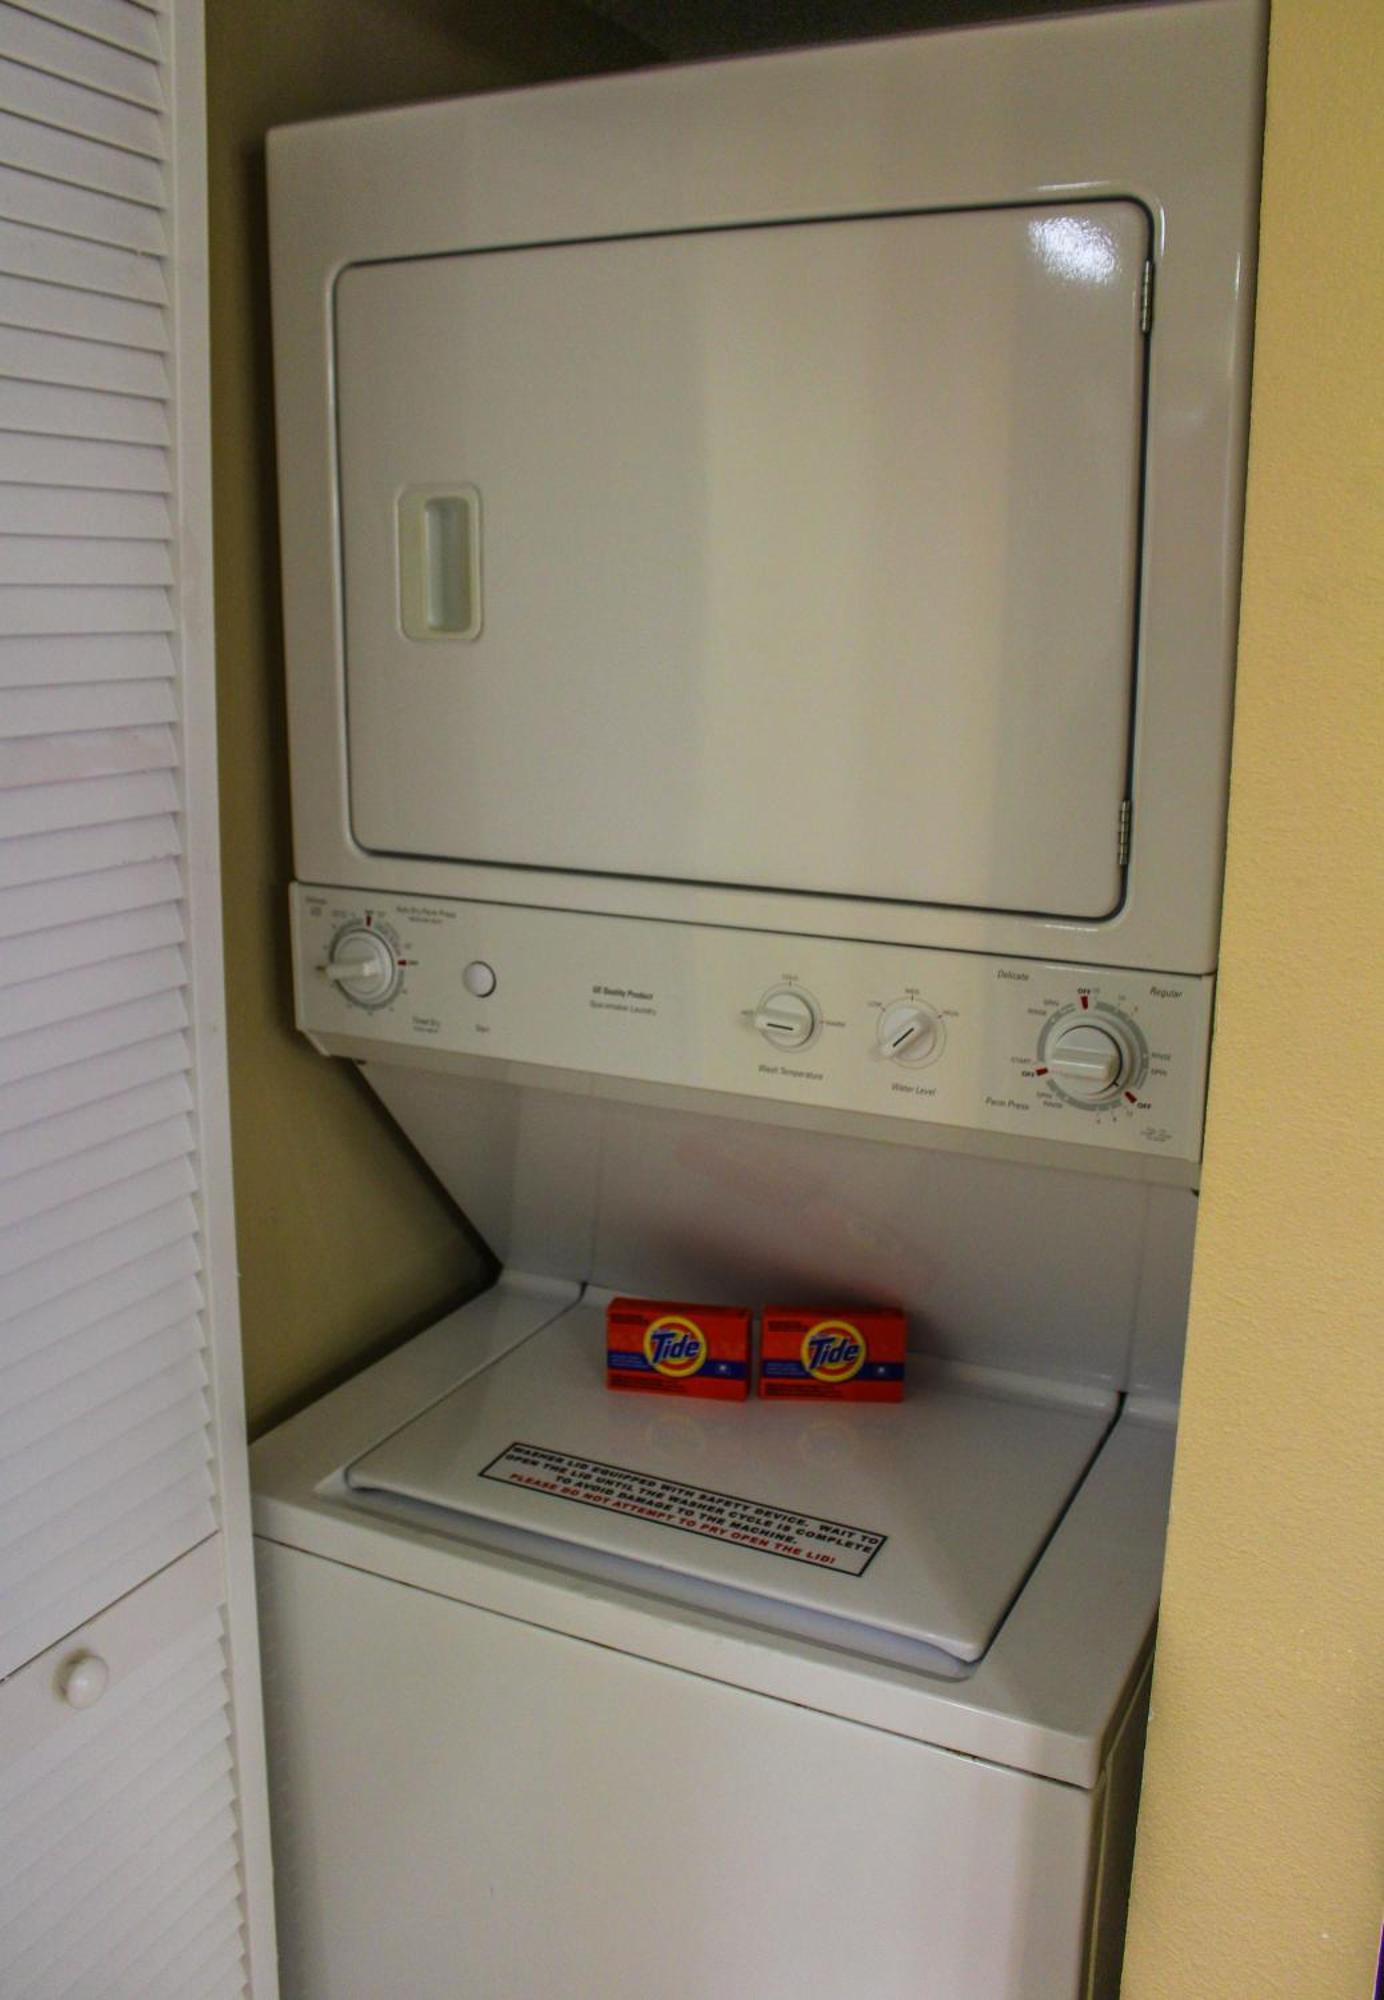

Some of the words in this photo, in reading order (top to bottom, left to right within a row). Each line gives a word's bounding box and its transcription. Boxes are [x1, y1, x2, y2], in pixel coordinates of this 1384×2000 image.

[997, 970, 1030, 982] Delicate
[1150, 986, 1183, 999] Regular
[1021, 1070, 1036, 1078] OFF
[891, 1082, 914, 1095] Water
[915, 1086, 936, 1097] Level
[985, 1096, 1007, 1108] Perm
[1008, 1098, 1030, 1111] Press
[1137, 1102, 1152, 1110] OFF
[651, 1331, 701, 1364] Tide
[808, 1336, 861, 1370] Tide
[505, 1454, 539, 1466] OPEN
[543, 1463, 568, 1474] THE
[570, 1471, 592, 1480] LID
[595, 1477, 633, 1491] UNTIL
[640, 1488, 665, 1499] THE
[668, 1495, 725, 1514] WASHER
[728, 1511, 774, 1528] CYCLE
[777, 1523, 792, 1532] IS
[796, 1528, 873, 1553] COMPLETE
[512, 1447, 565, 1463] WASHER
[567, 1460, 589, 1470] LID
[591, 1467, 656, 1487] EQUIPPED
[660, 1484, 695, 1497] WITH
[698, 1494, 750, 1512] SAFETY
[754, 1505, 809, 1527] DEVICE.
[819, 1525, 856, 1538] WAIT
[861, 1535, 879, 1545] TO
[510, 1473, 557, 1490] PLEASE
[560, 1487, 580, 1496] DO
[583, 1492, 612, 1504] NOT
[612, 1501, 675, 1521] ATTEMPT
[679, 1518, 697, 1527] TO
[700, 1523, 729, 1535] PRY
[731, 1531, 769, 1547] OPEN
[773, 1543, 802, 1555] THE
[806, 1551, 837, 1564] LID!
[556, 1475, 571, 1484] TO
[574, 1481, 614, 1495] AVOID
[617, 1492, 673, 1511] DAMAGE
[678, 1508, 695, 1517] TO
[700, 1513, 726, 1524] THE
[729, 1521, 798, 1544] MACHINE.
